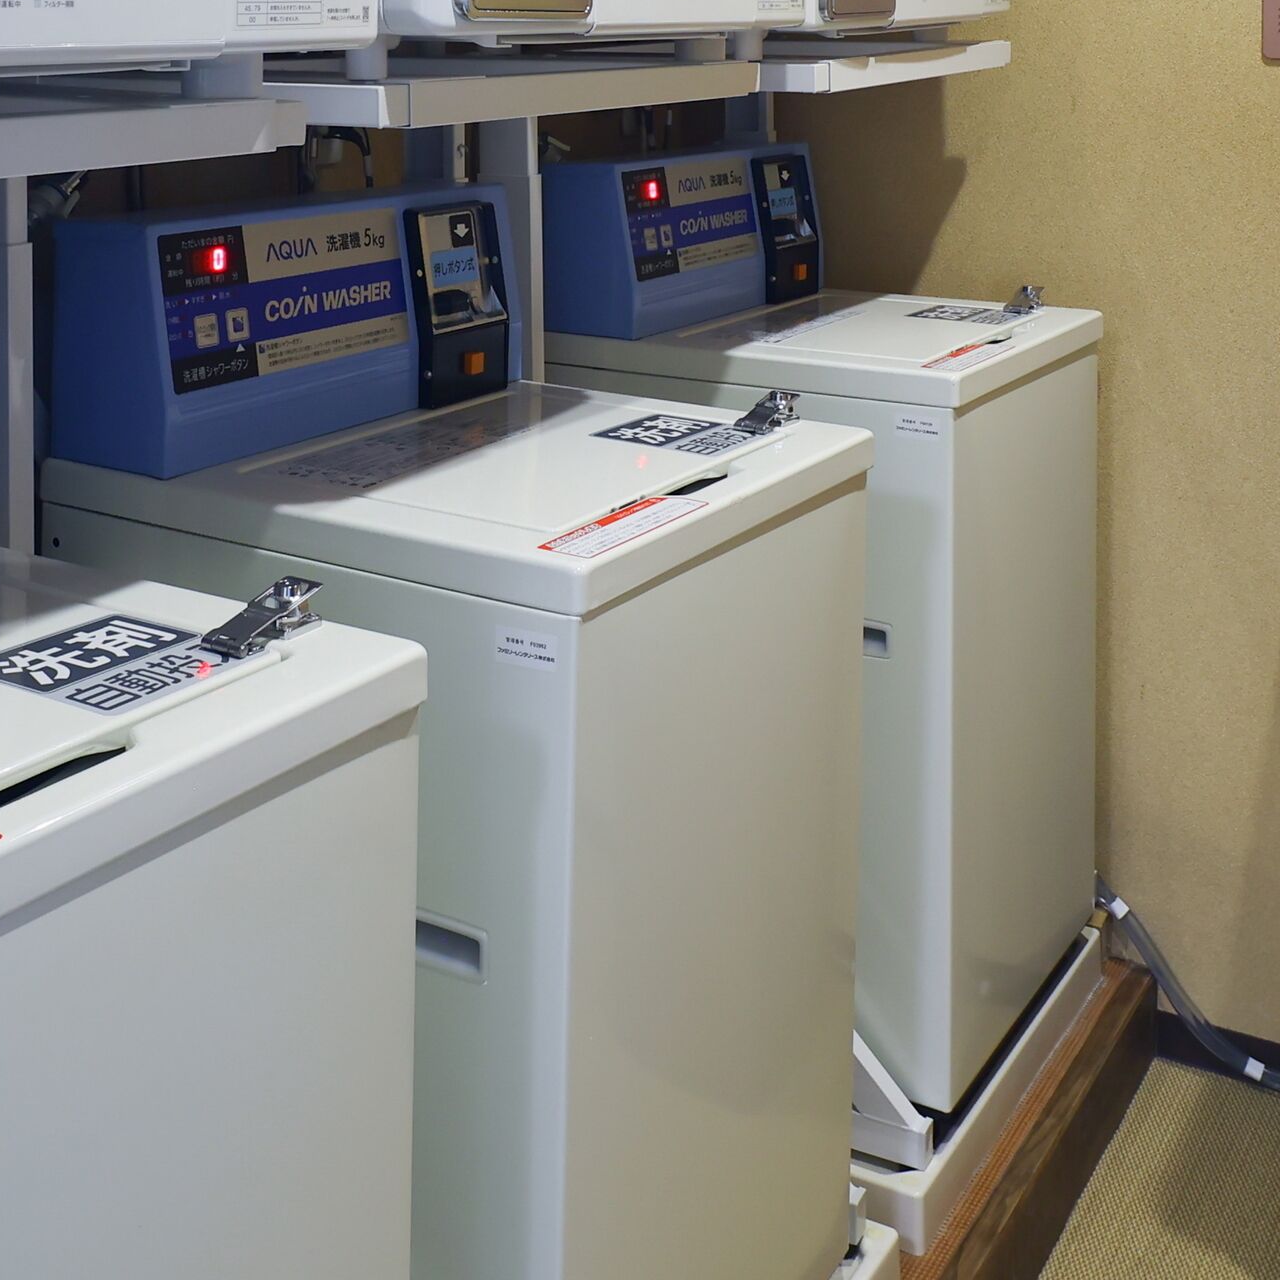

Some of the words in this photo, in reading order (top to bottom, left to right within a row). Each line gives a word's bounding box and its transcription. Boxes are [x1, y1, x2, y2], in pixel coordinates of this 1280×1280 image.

[678, 175, 706, 194] AQUA
[710, 209, 748, 230] WASHER
[266, 237, 318, 262] AQUA
[326, 231, 362, 253] 洗濯機
[364, 228, 385, 249] 5kg
[212, 248, 225, 271] 0
[434, 258, 475, 278] 押しボタン式
[322, 280, 391, 311] WASHER
[608, 415, 711, 445] 洗剤
